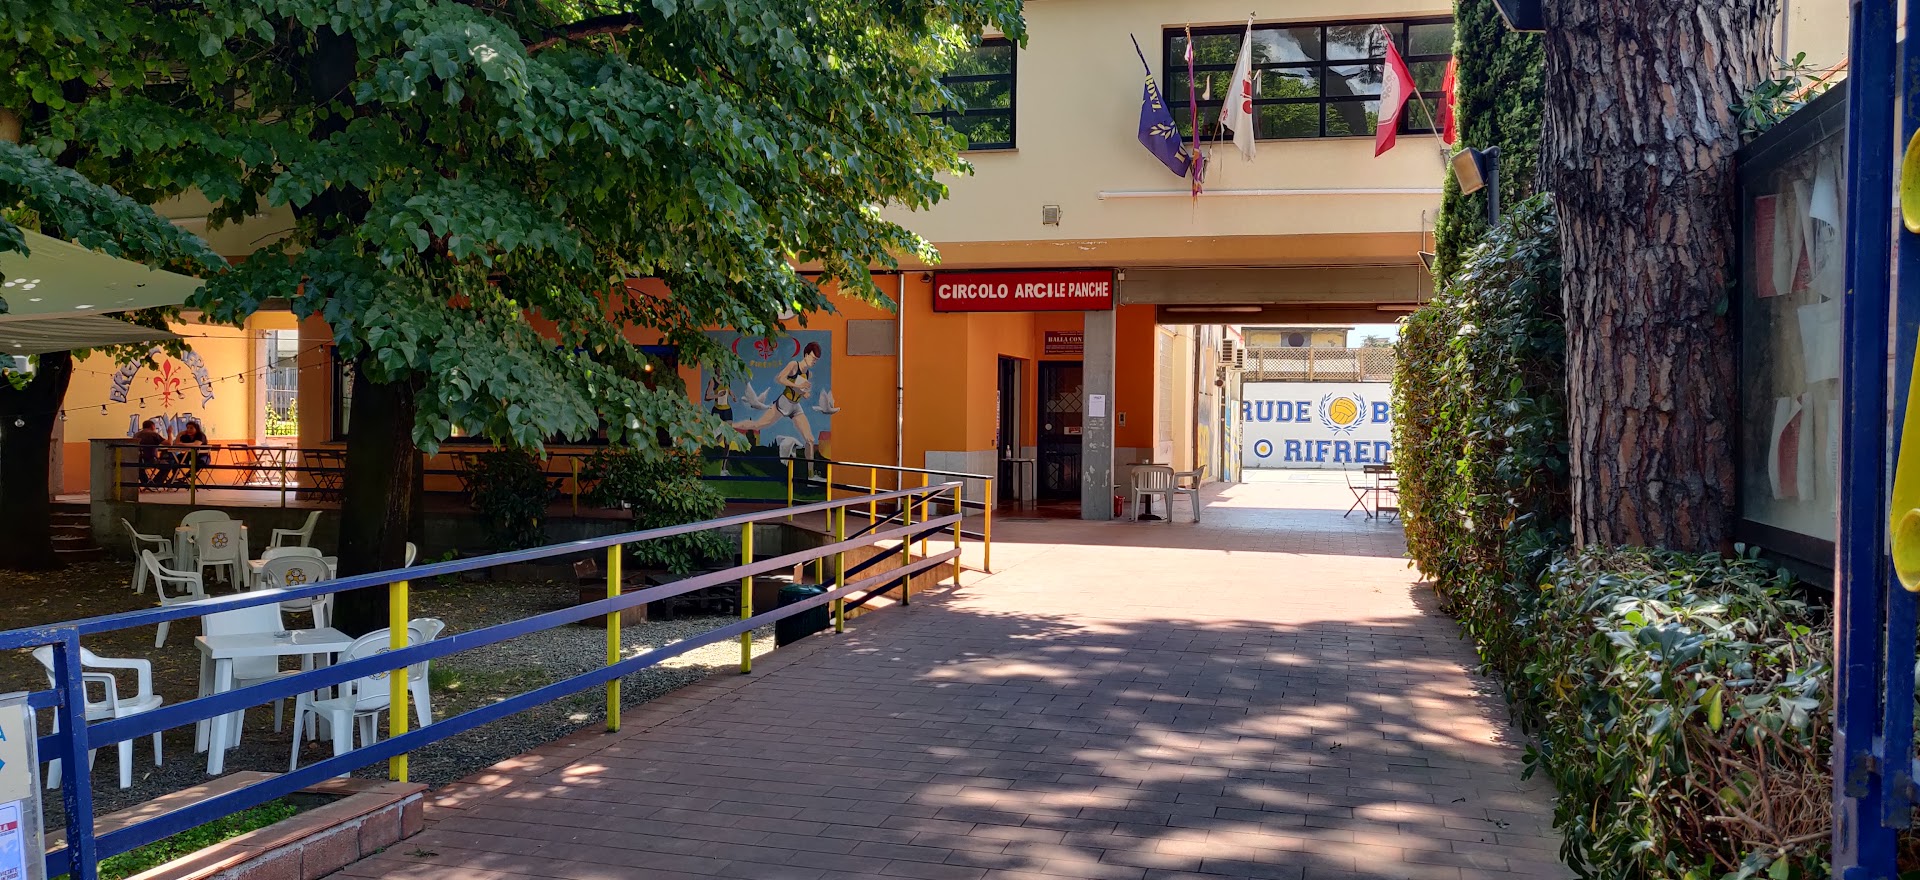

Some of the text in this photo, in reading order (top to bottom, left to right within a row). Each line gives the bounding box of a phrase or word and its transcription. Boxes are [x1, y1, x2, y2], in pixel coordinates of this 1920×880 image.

[938, 281, 1109, 300] CIRCOLO ARCI LE PANCHE
